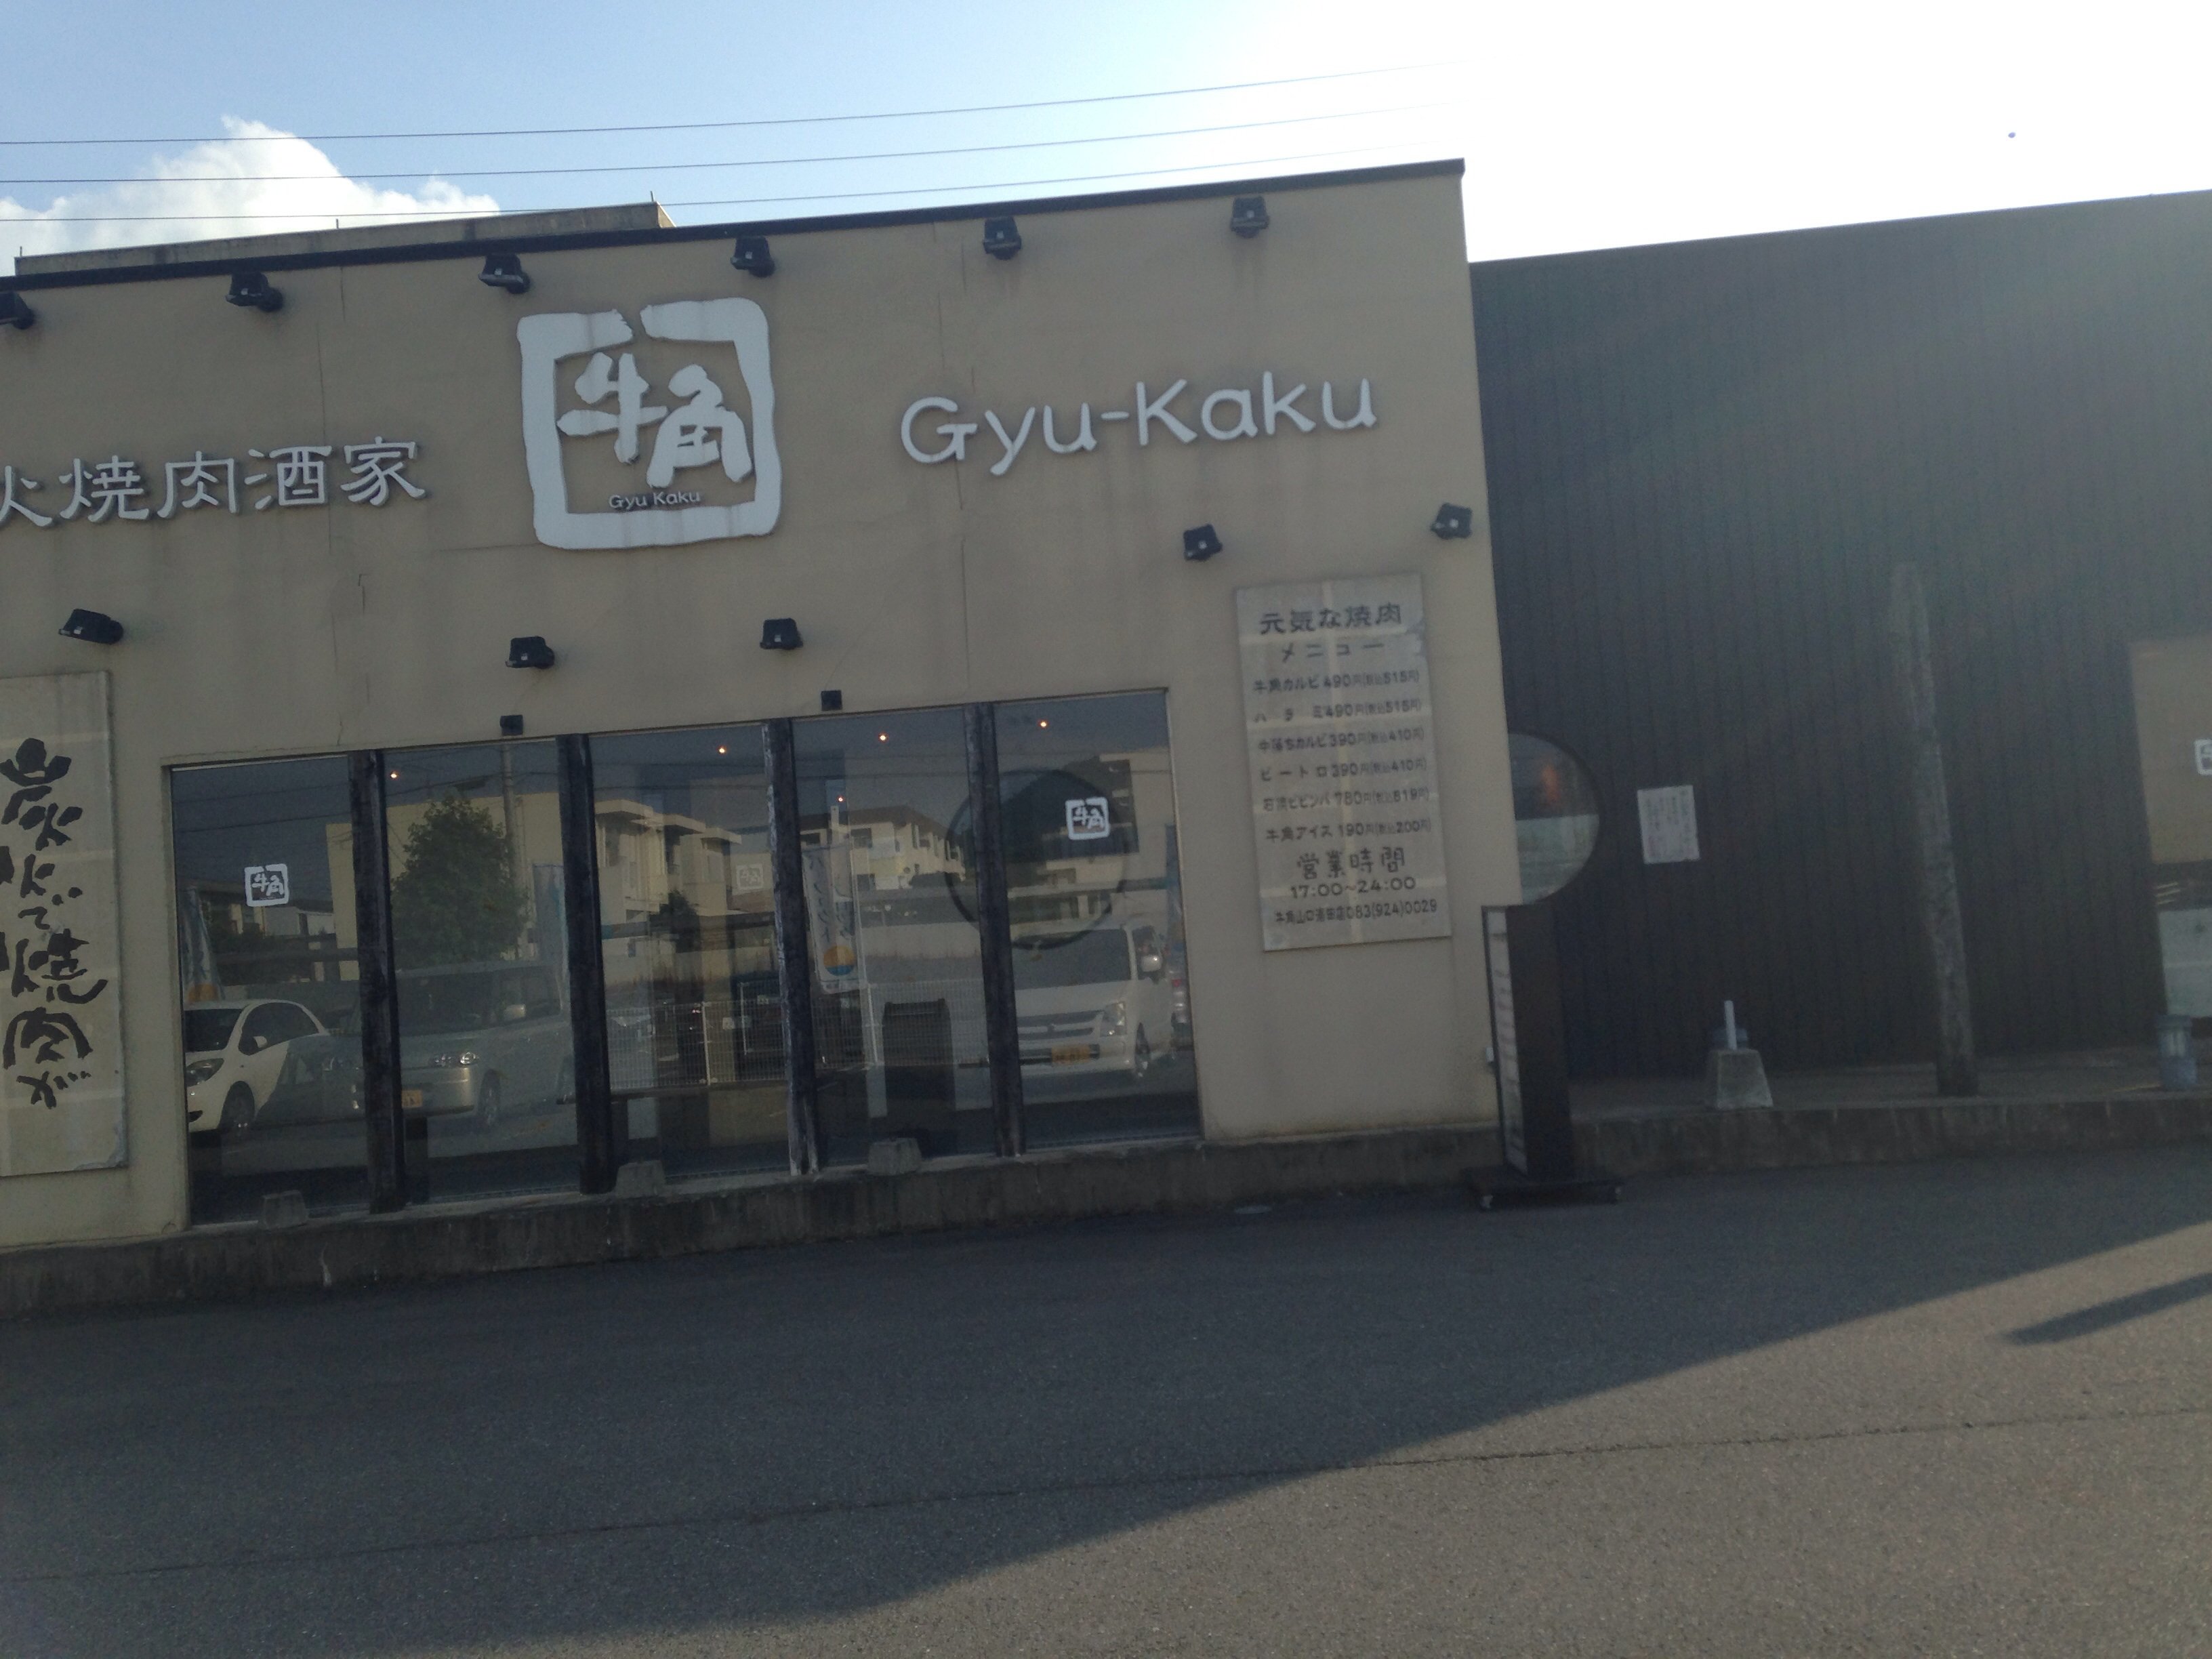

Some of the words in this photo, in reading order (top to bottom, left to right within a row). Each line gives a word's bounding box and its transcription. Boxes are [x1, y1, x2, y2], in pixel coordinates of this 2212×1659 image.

[556, 352, 752, 488] 牛角
[900, 371, 1378, 476] Gyu-Kaku
[609, 494, 648, 510] Gyu
[653, 491, 701, 506] Kaku
[1259, 602, 1402, 635] 元気な焼肉
[1282, 642, 1385, 663] メニュー
[1296, 846, 1406, 880] 営業時間
